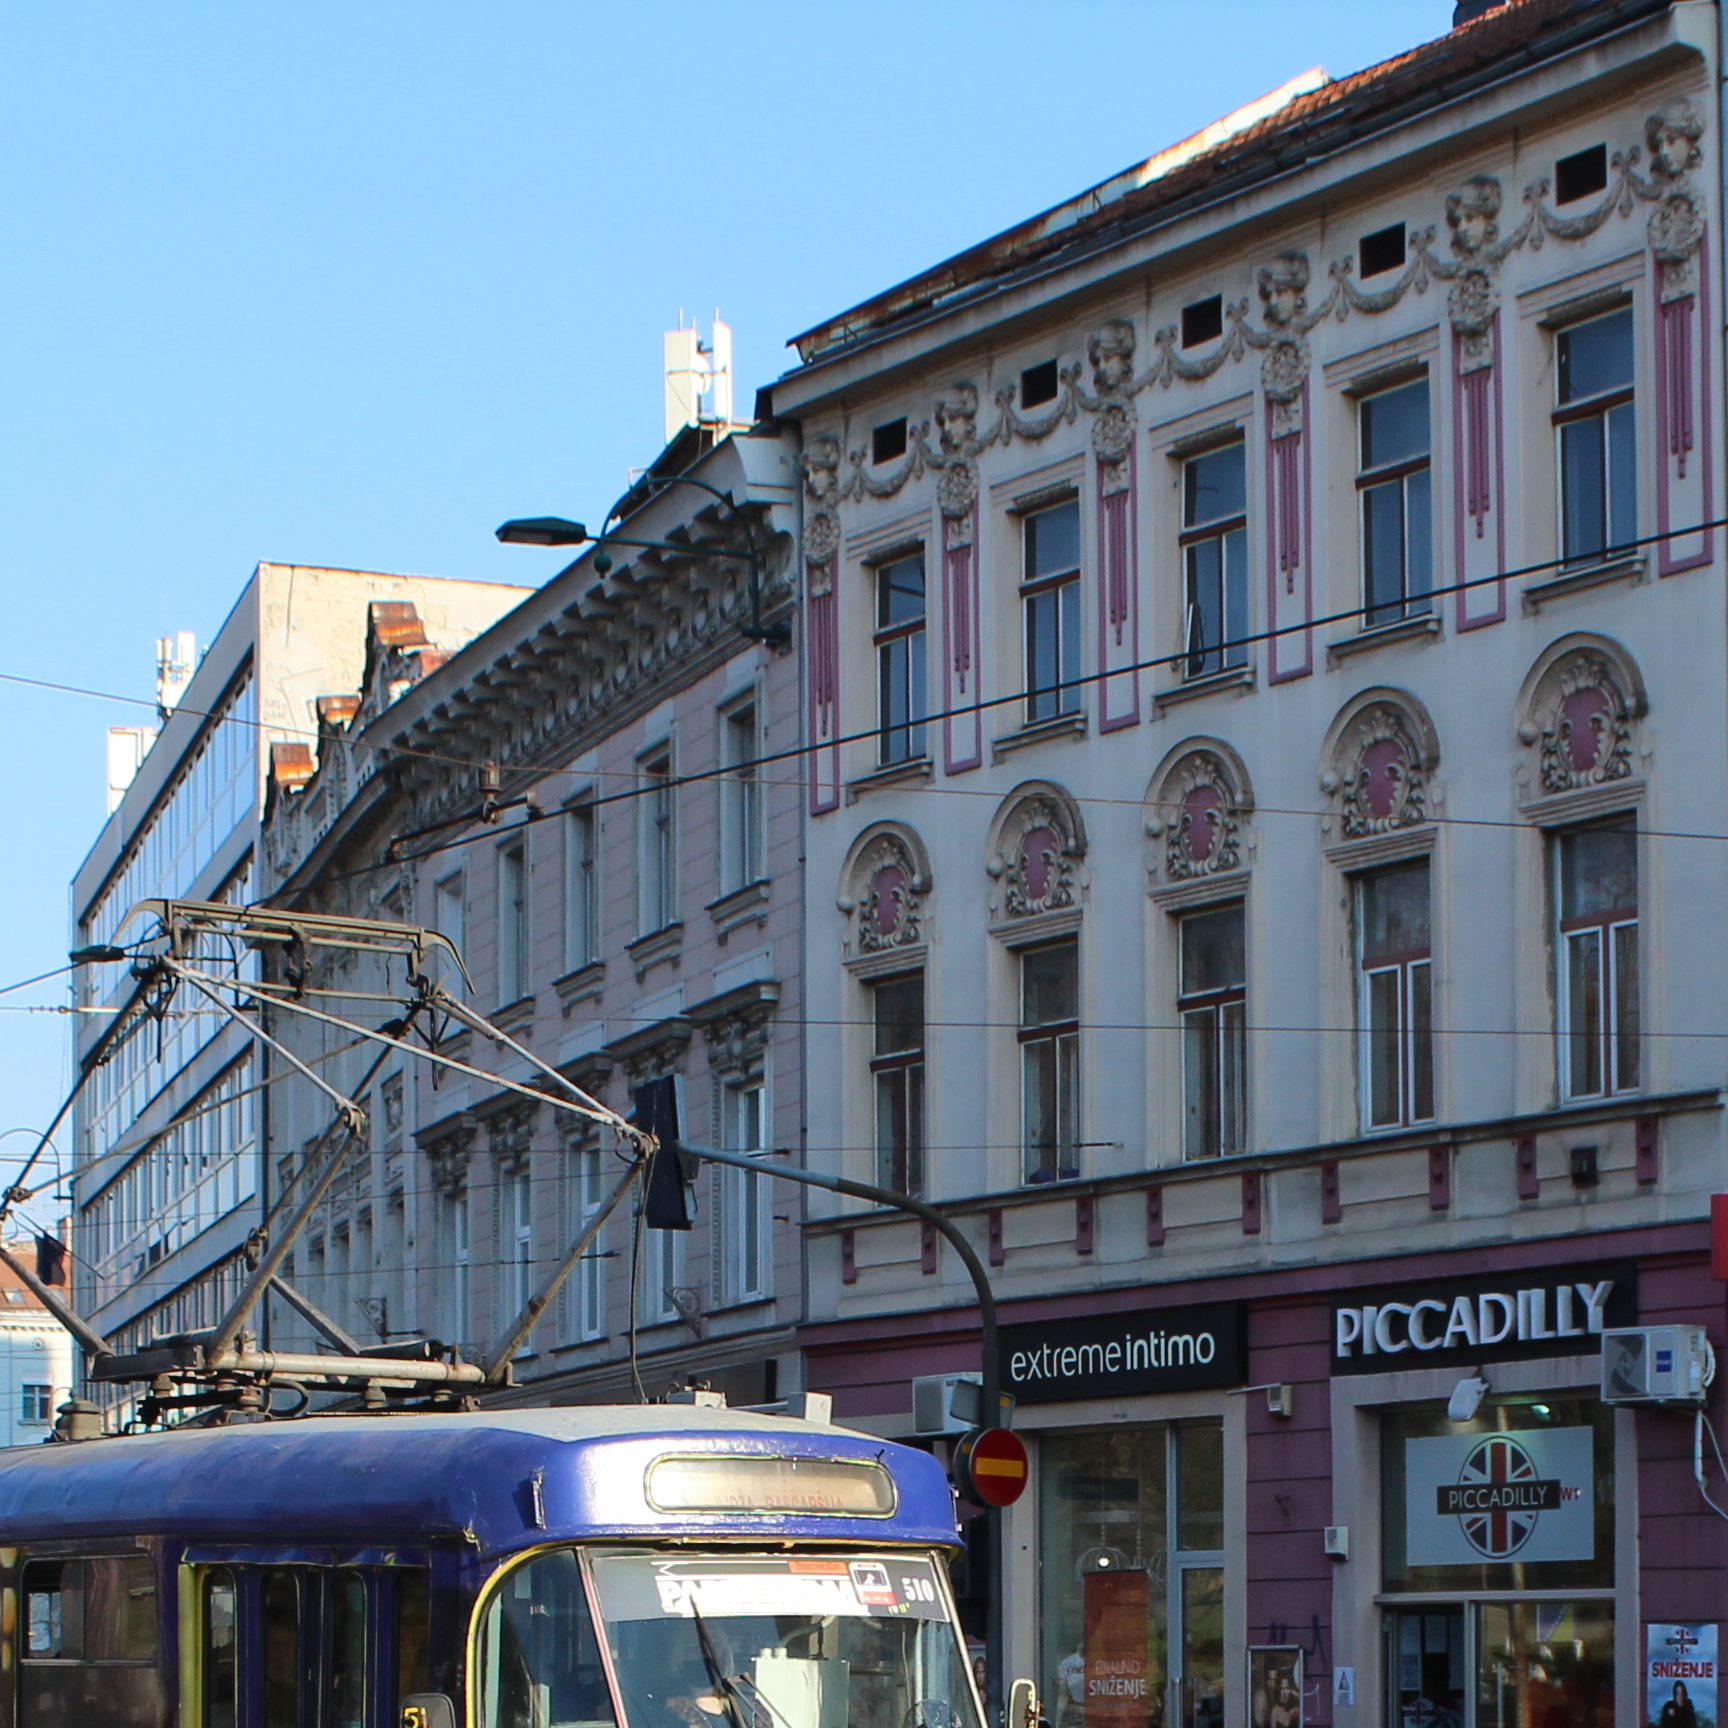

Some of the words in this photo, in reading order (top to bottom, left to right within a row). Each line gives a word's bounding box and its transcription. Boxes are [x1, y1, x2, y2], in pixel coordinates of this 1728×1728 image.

[1336, 1280, 1615, 1358] PICCADILLY
[1010, 1342, 1122, 1382] extreme
[1125, 1330, 1215, 1370] intimo
[1448, 1485, 1548, 1509] PICCADILLY
[900, 1576, 935, 1602] 510
[1651, 1657, 1714, 1678] SNIŽENJE
[1088, 1674, 1147, 1700] SNIŽENJE
